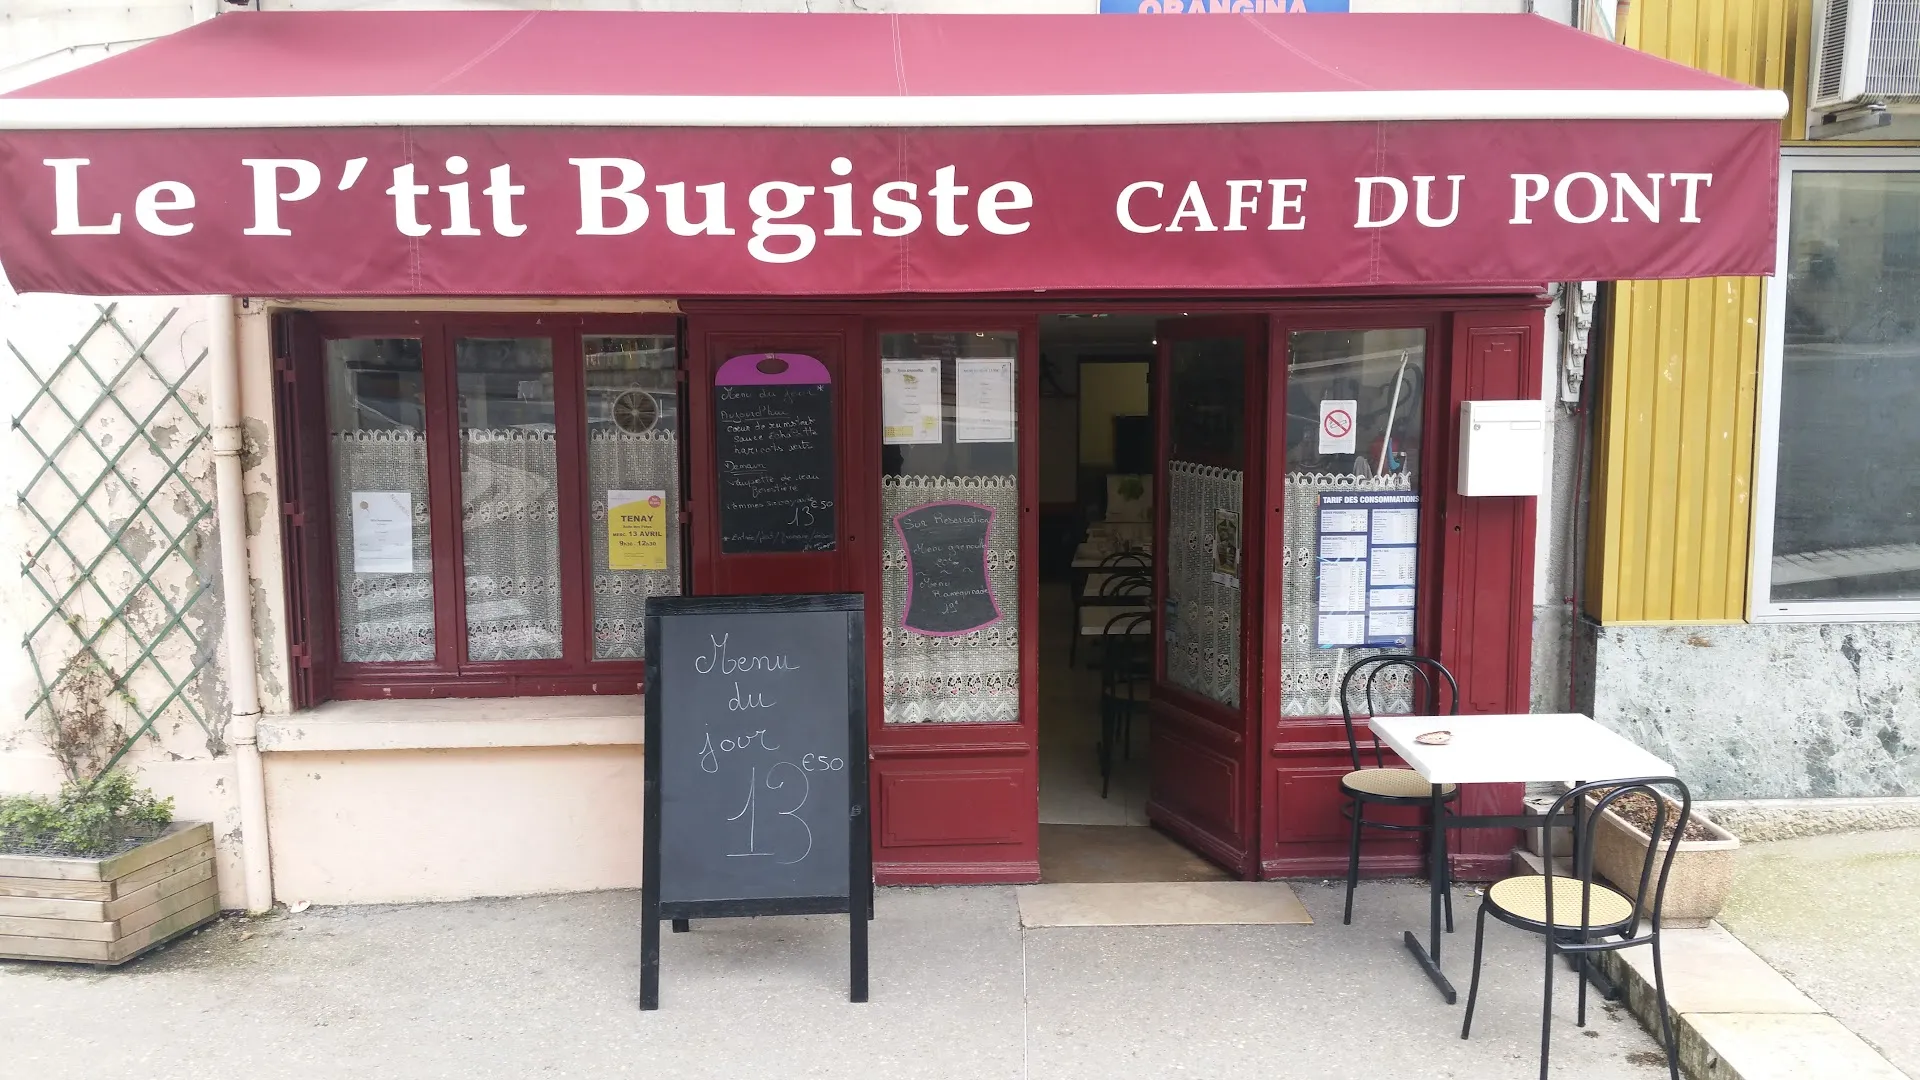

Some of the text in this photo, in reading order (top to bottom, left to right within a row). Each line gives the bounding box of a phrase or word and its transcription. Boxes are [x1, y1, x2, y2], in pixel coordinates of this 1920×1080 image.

[43, 157, 196, 237] Le
[570, 156, 1034, 263] Bugiste
[1115, 171, 1714, 234] CAFE DU PONT
[721, 386, 752, 401] Menu
[755, 421, 766, 430] de
[724, 460, 767, 470] Demain
[1322, 495, 1420, 504] TARIF DES CONSOMMATIONS
[904, 515, 928, 531] Sur
[913, 543, 943, 556] Menu
[695, 632, 801, 675] Menu
[728, 681, 777, 712] du
[698, 722, 781, 774] jour
